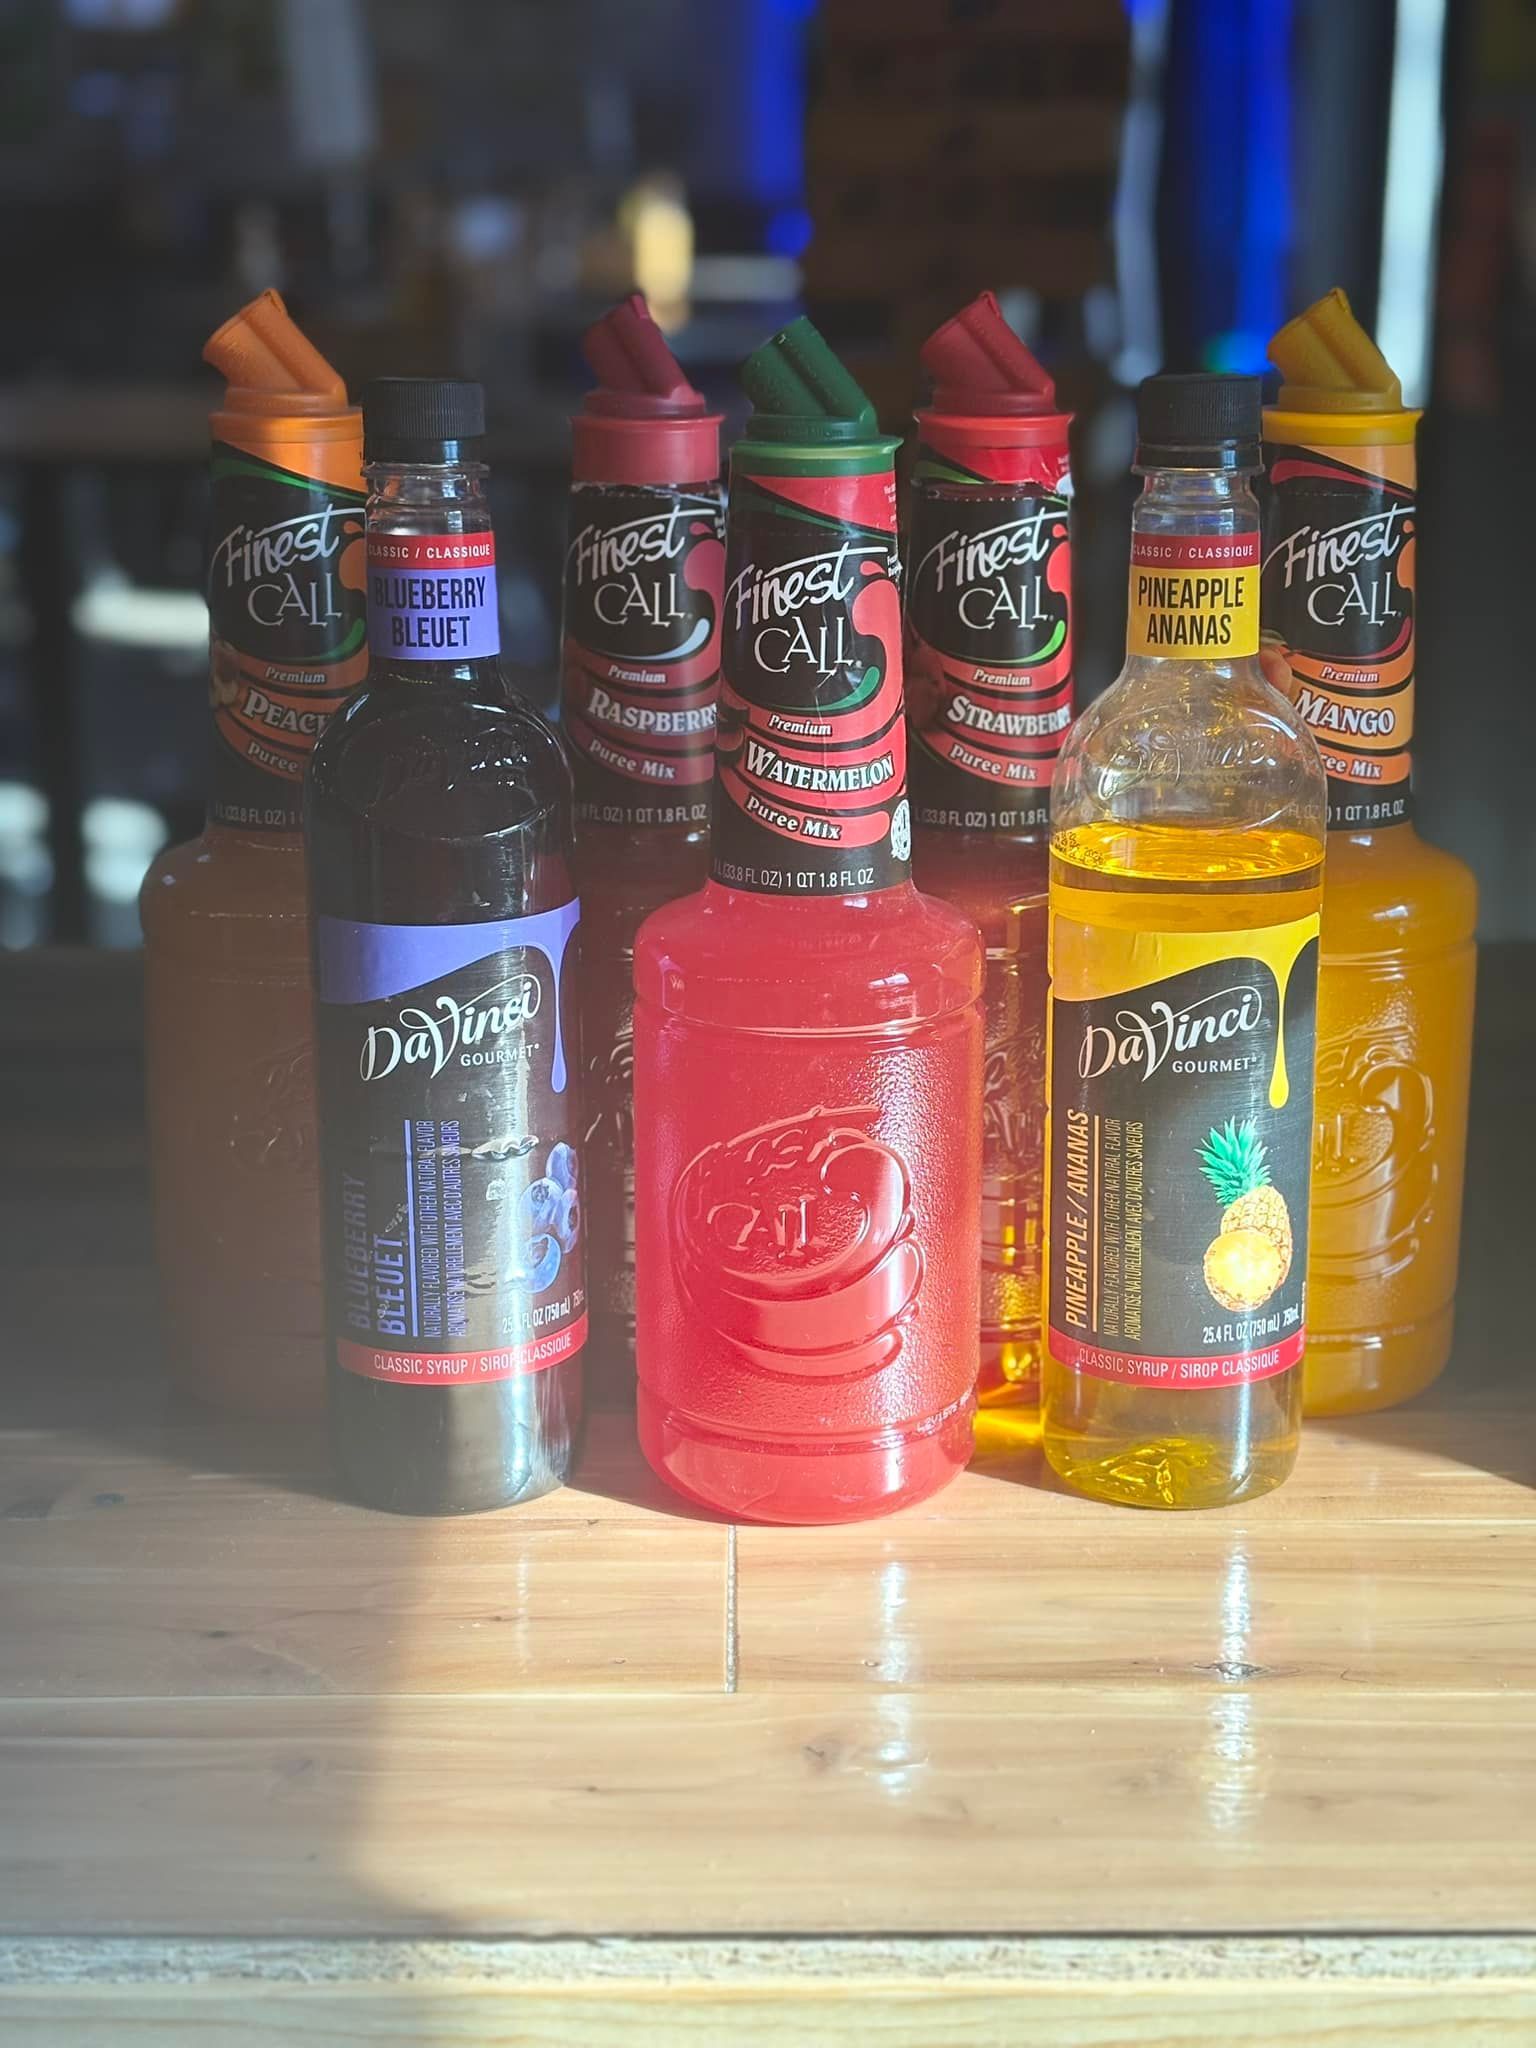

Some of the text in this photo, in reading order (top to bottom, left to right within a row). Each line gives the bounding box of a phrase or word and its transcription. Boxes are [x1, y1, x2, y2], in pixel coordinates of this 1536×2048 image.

[214, 504, 365, 586] Finest
[427, 544, 490, 558] CLASSIQUE
[564, 505, 716, 586] Finest
[914, 506, 1068, 592] Finest
[1188, 545, 1253, 559] CLASSIQUE
[1262, 502, 1416, 588] Finest
[248, 572, 341, 628] CALL
[375, 576, 486, 609] BLUEBERRY
[594, 573, 685, 627] CALL
[726, 541, 889, 630] Finest
[958, 575, 1048, 631] CALL
[1138, 575, 1245, 609] PINEAPPLE
[1307, 571, 1398, 627] CALL
[392, 616, 471, 647] BLEUET
[754, 616, 854, 675] CALL
[1147, 613, 1232, 645] ANANAS
[265, 666, 325, 685] Premium
[608, 665, 666, 684] Premium
[972, 668, 1031, 687] Premium
[1321, 666, 1379, 684] Premium
[768, 714, 832, 736] Premium
[1295, 688, 1396, 736] MANGO
[248, 741, 298, 773] Puree
[590, 739, 675, 780] Puree Mix
[745, 741, 894, 793] WATERMELON
[950, 743, 1036, 781] Puree Mix
[1351, 760, 1381, 779] Mix
[636, 808, 654, 823] QT
[657, 808, 674, 823] 1.8
[675, 807, 689, 821] FL
[691, 804, 707, 820] OZ
[746, 796, 841, 839] Puree Mix
[948, 811, 962, 827] FL
[965, 811, 987, 829] OZ)
[991, 812, 996, 827] 1
[999, 811, 1018, 827] QT
[1020, 809, 1035, 825] 1.8
[1036, 808, 1049, 823] FL
[1345, 805, 1362, 821] QT
[1365, 804, 1380, 819] 1.8
[1381, 802, 1392, 817] FL
[1393, 799, 1405, 815] OZ
[745, 868, 758, 884] FL
[761, 870, 783, 888] OZ)
[786, 873, 791, 888] 1
[797, 872, 816, 888] QT
[820, 872, 837, 888] 1.8
[841, 871, 855, 887] FL
[858, 868, 874, 885] OZ
[360, 973, 542, 1082] DaVinci
[1079, 985, 1263, 1083] DaVinci
[416, 1121, 435, 1153] FLAVOR
[440, 1121, 460, 1156] SAVEURS
[1066, 1109, 1089, 1197] ANANAS
[1126, 1121, 1143, 1159] SAVEURS
[442, 1159, 461, 1198] D'AUTRES
[1125, 1160, 1143, 1200] D'AUTRES
[418, 1195, 437, 1221] OTHER
[443, 1200, 461, 1220] AVEC
[1125, 1201, 1143, 1223] AVEC
[420, 1224, 438, 1245] WITH
[1104, 1118, 1121, 1337] NATURALLY FLAVORED WITH OTHER NATURAL FLAVOR
[342, 1172, 371, 1329] BLUEBERRY
[421, 1247, 441, 1289] FLAVORED
[444, 1222, 464, 1290] NATURELLEMENT
[1124, 1224, 1143, 1292] NATURELLEMENT
[374, 1233, 406, 1336] BLEUET
[1066, 1213, 1089, 1328] PINEAPPLE
[422, 1292, 442, 1337] NATURALLY
[533, 1308, 545, 1327] OZ
[1203, 1326, 1223, 1344] 25.4
[1224, 1324, 1234, 1342] FL
[1236, 1321, 1248, 1340] OZ
[1249, 1318, 1266, 1338] (750
[1267, 1312, 1280, 1332] mL)
[374, 1345, 422, 1374] CLASSIC
[427, 1355, 468, 1376] SYRUP
[480, 1350, 514, 1373] SIROP
[520, 1332, 572, 1364] CLASSIQUE
[1079, 1347, 1124, 1374] CLASSIC
[1127, 1357, 1169, 1379] SYRUP
[1181, 1355, 1218, 1379] SIROP
[1222, 1349, 1280, 1377] CLASSIQUE
